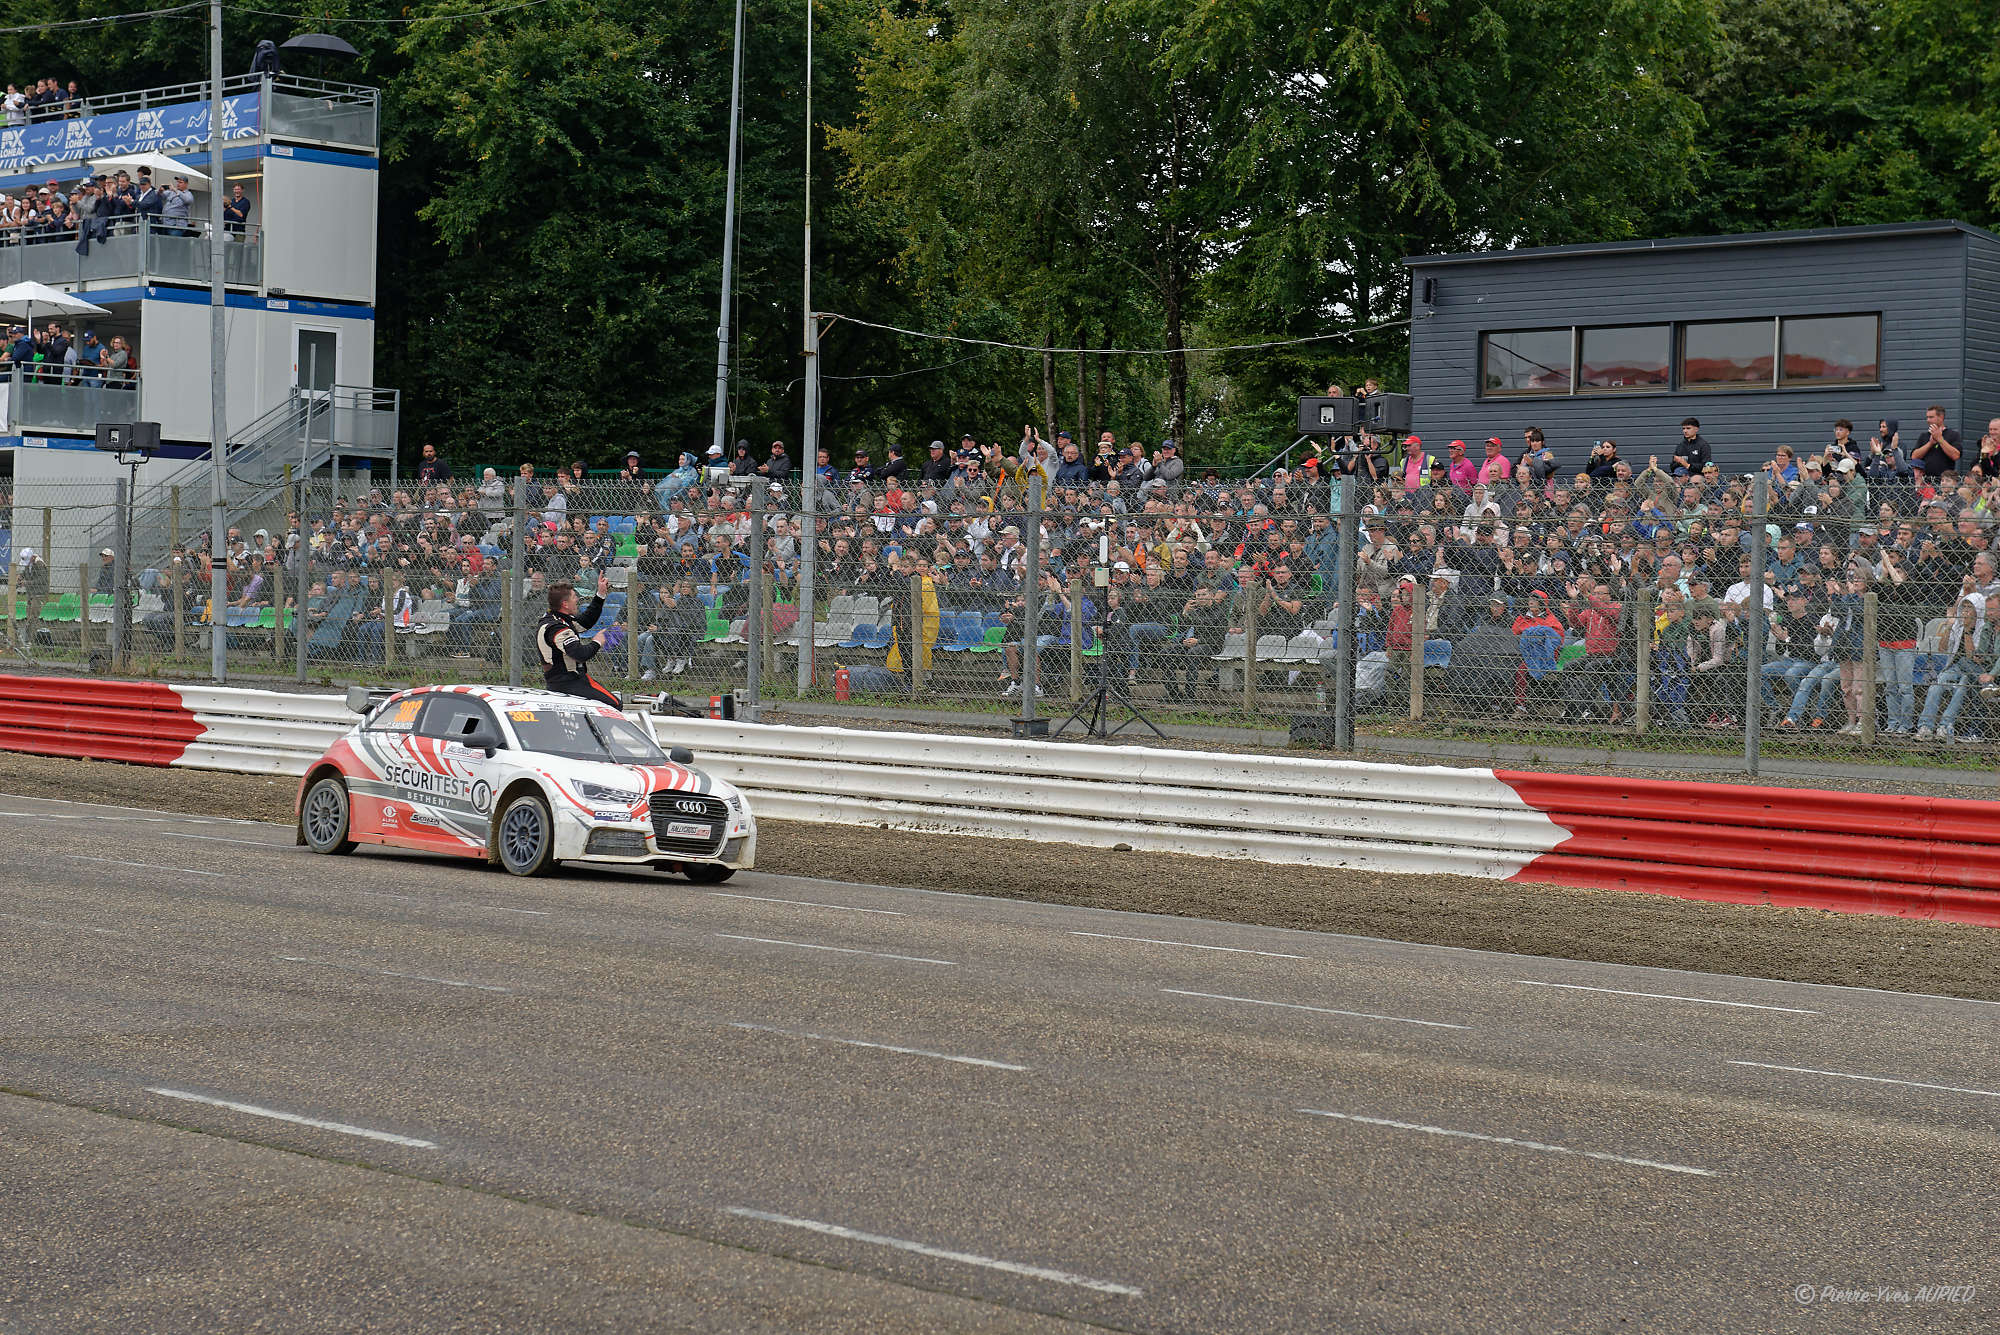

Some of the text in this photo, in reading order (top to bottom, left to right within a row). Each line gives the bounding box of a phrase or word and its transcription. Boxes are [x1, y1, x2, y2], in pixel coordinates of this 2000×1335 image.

[394, 699, 423, 722] 302
[508, 711, 540, 722] 302
[385, 764, 469, 797] SECURITEST
[407, 791, 451, 807] BETHENY
[594, 811, 632, 819] COOPER
